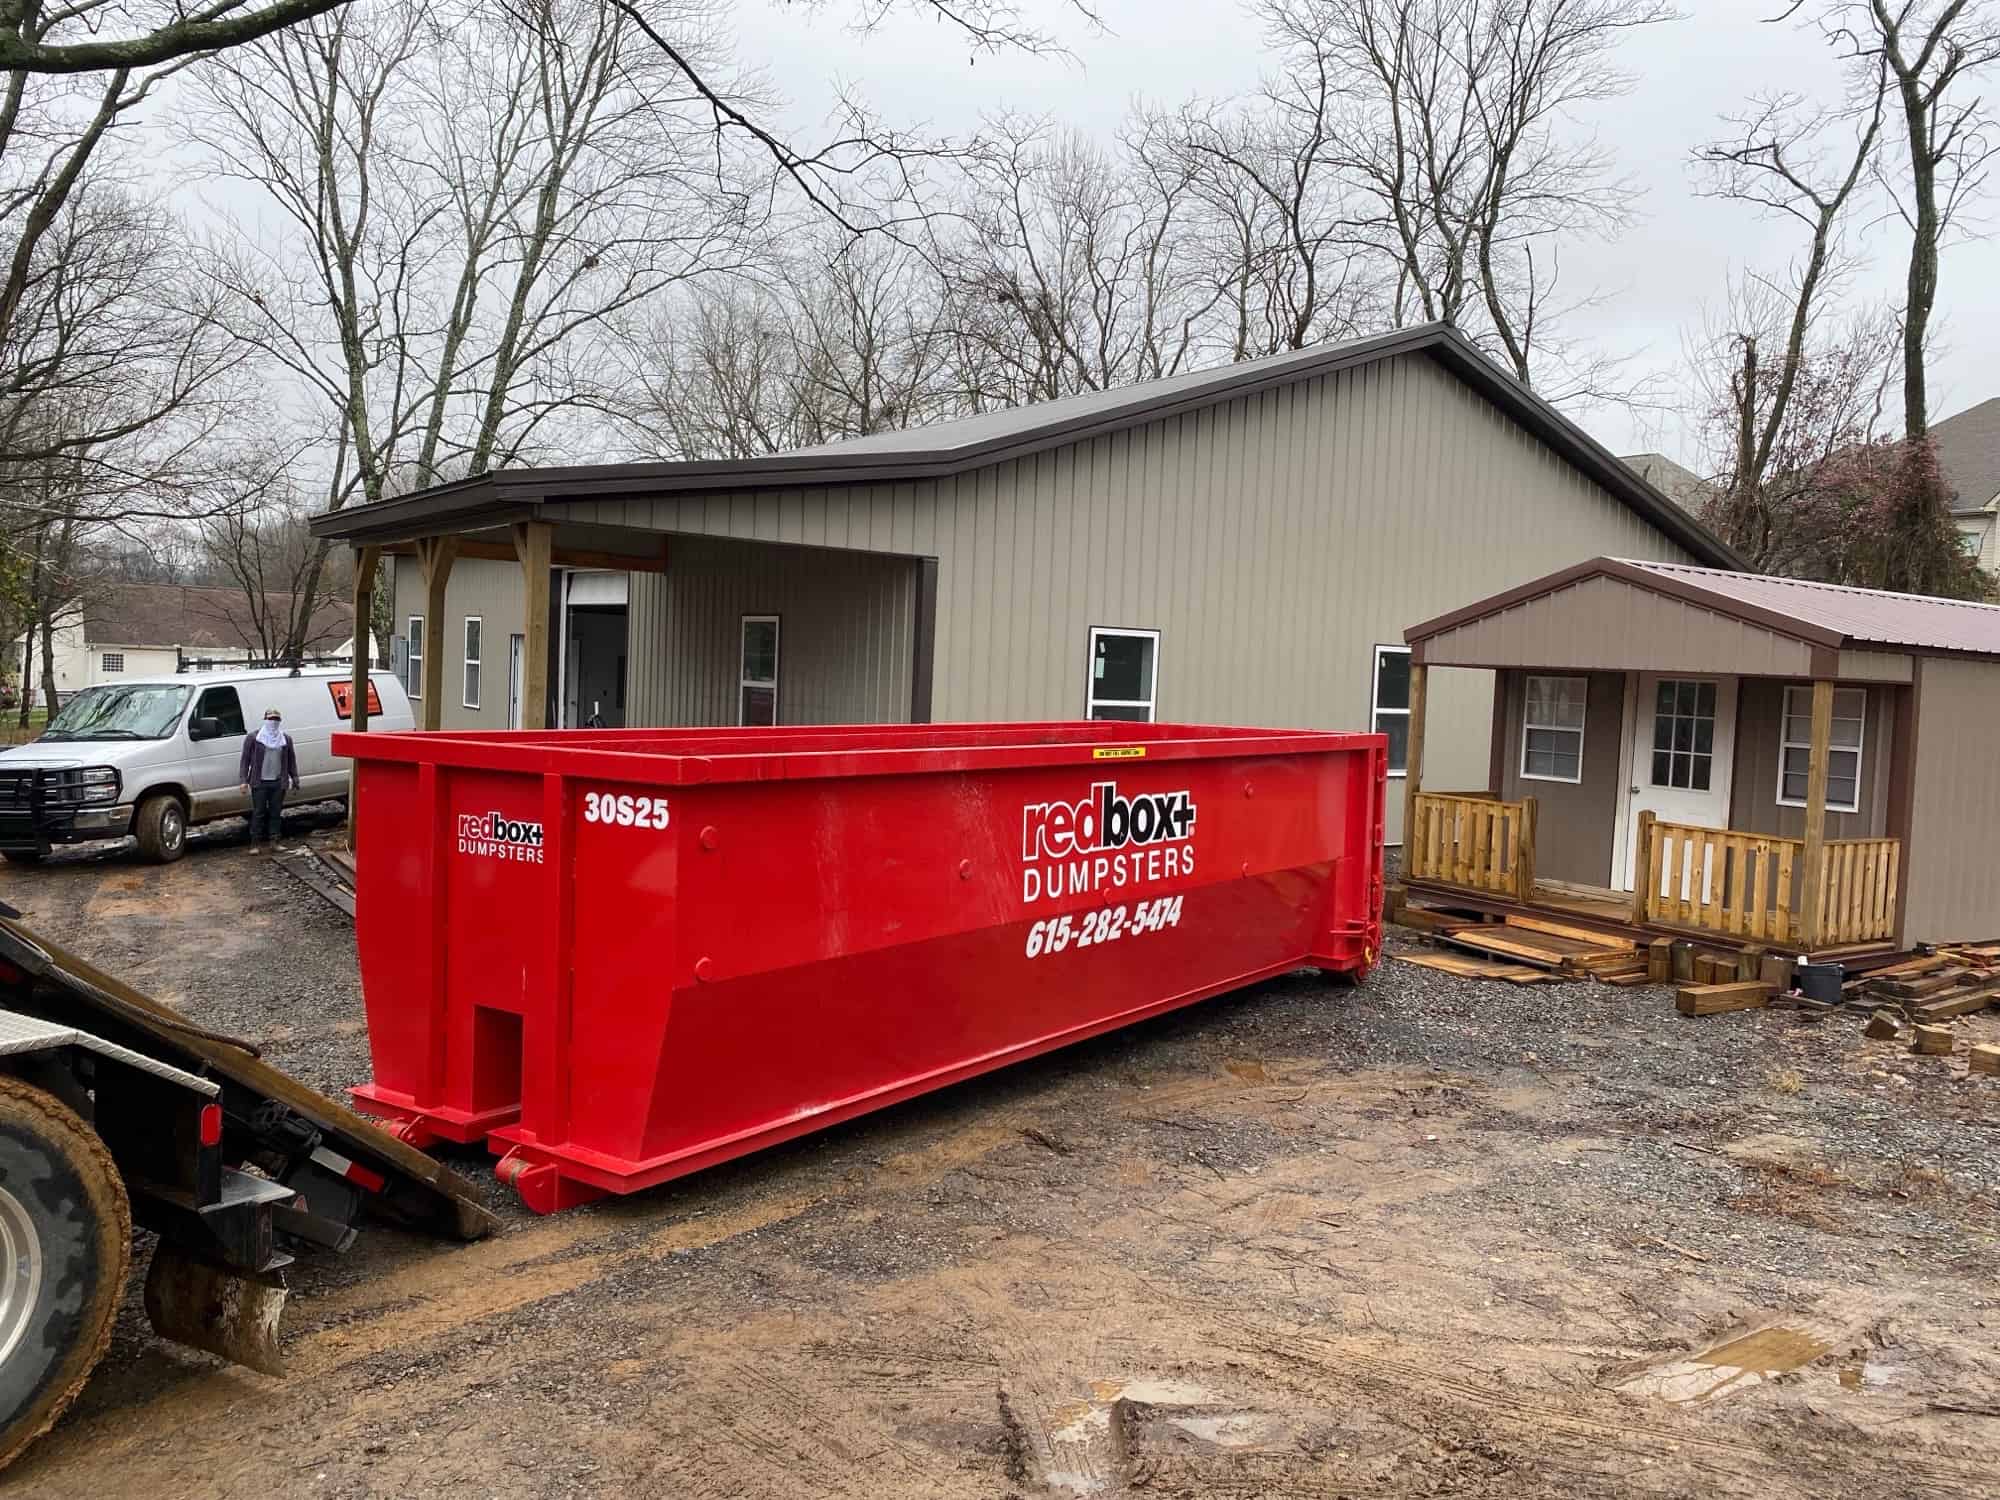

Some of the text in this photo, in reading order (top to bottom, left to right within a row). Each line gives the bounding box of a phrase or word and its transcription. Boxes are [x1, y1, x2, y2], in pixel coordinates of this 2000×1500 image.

[458, 811, 543, 846] redbox+
[585, 792, 670, 830] 30S25
[1023, 781, 1197, 862] redbox+
[458, 839, 544, 864] DUMPSTERS
[1023, 845, 1194, 903] DUMPSTERS
[1025, 895, 1184, 959] 615-282-5474
